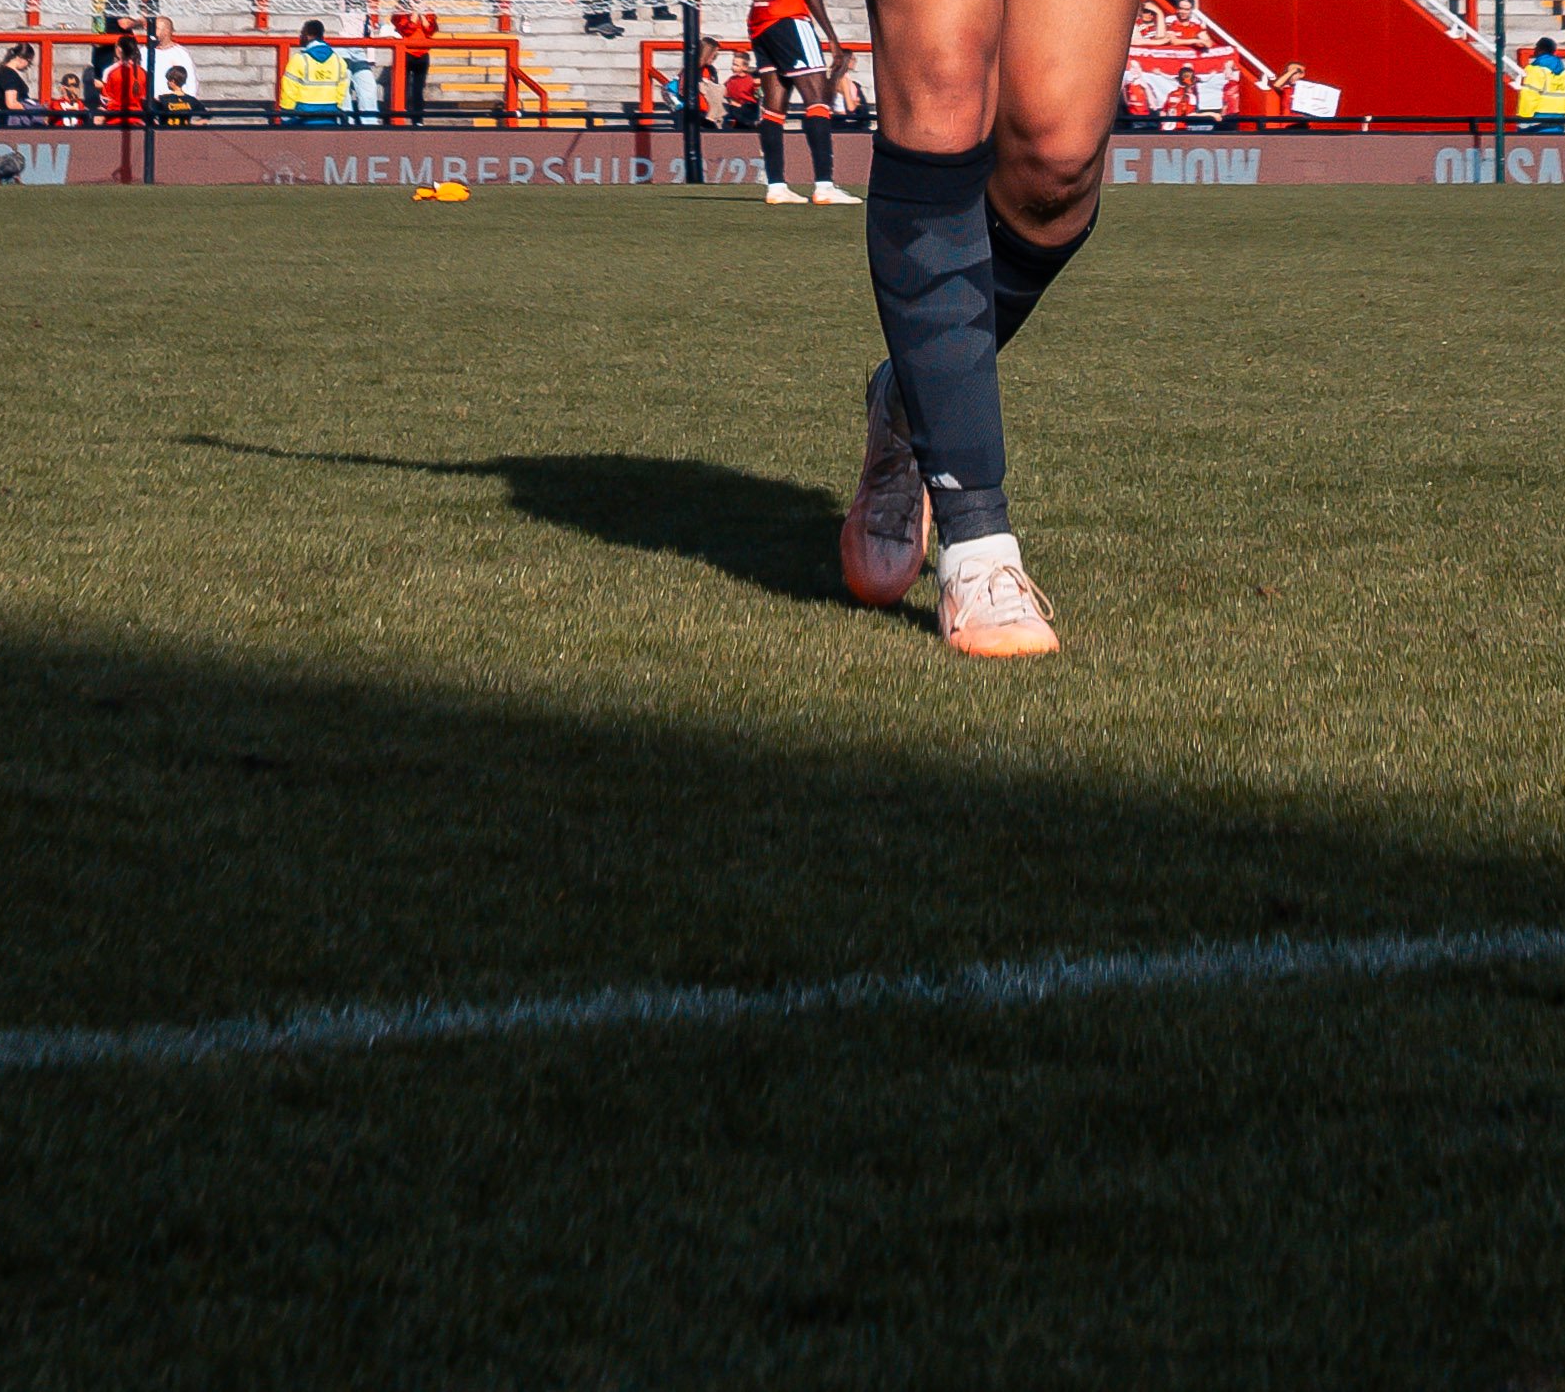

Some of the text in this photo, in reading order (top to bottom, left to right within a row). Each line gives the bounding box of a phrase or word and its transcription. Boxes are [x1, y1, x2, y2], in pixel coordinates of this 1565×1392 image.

[669, 157, 766, 185] 2/27
[1151, 147, 1262, 184] NOW
[1435, 147, 1496, 184] ON
